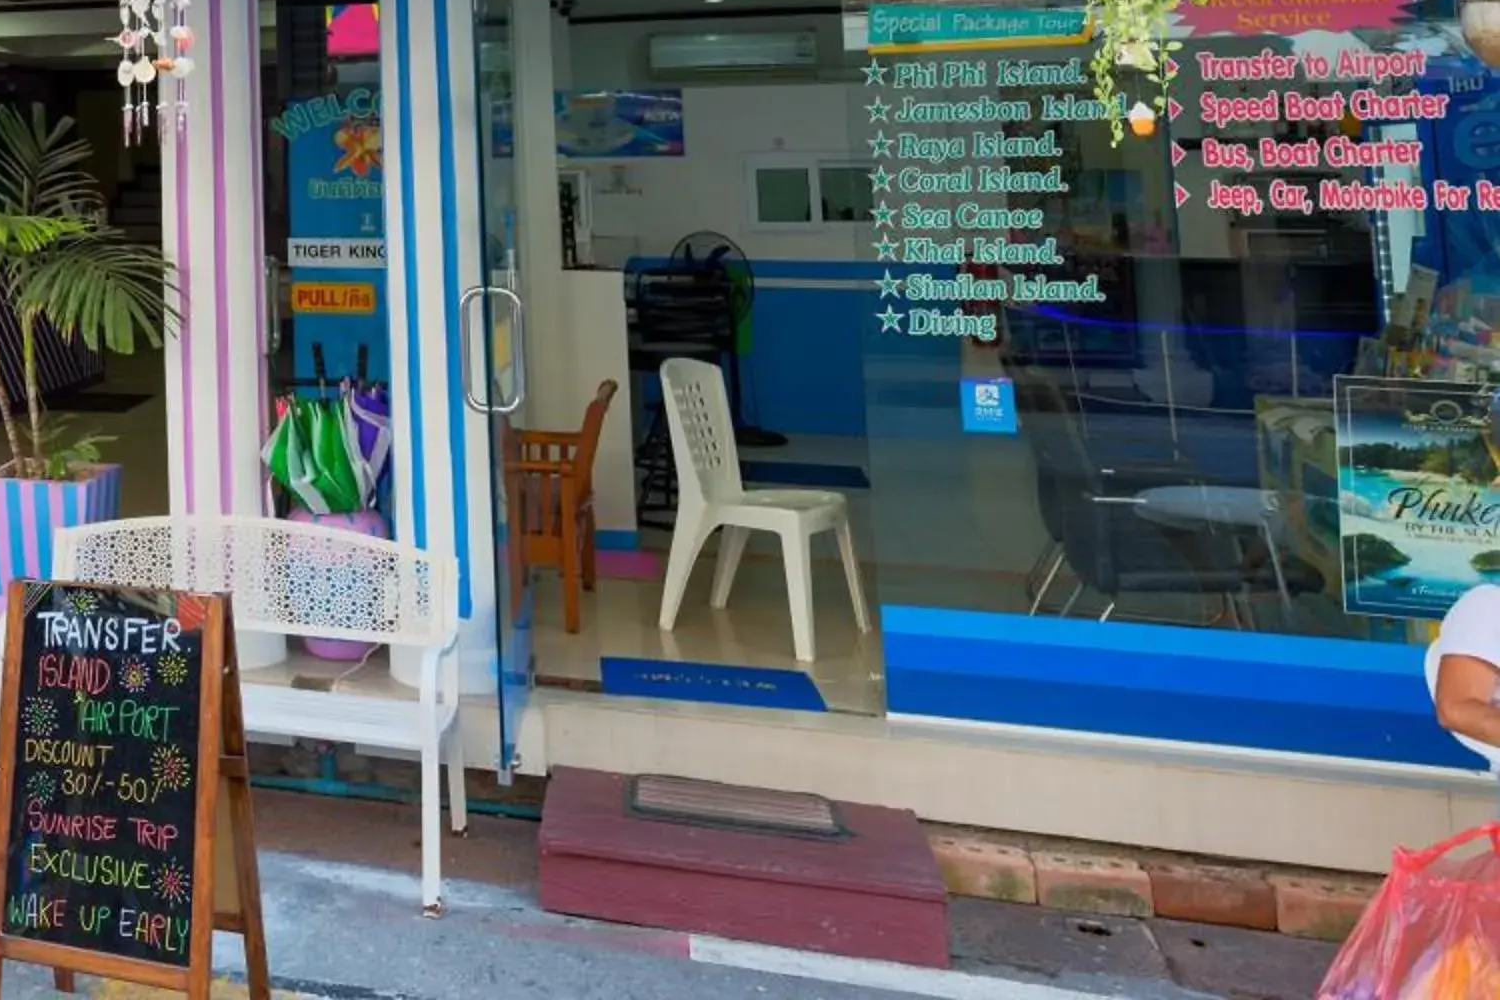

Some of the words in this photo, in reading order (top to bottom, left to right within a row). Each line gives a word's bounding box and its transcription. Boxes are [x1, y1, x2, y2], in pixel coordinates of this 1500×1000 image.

[873, 9, 941, 41] Special
[953, 14, 1029, 34] Package
[1037, 15, 1079, 31] Tour
[1236, 9, 1331, 29] Service
[893, 62, 937, 89] Phi
[942, 60, 987, 88] Phi
[997, 58, 1087, 87] Island.
[1197, 49, 1298, 81] Transfer
[1303, 52, 1331, 80] to
[1337, 49, 1427, 87] Airport
[270, 88, 382, 142] WELC
[895, 97, 1030, 124] Jamesbon
[1201, 90, 1278, 128] Speed
[1284, 91, 1346, 121] Boat
[1350, 89, 1449, 120] Charter
[898, 133, 965, 162] Raya
[972, 131, 1064, 157] Island.
[1202, 137, 1255, 170] Bus,
[1260, 136, 1321, 167] Boat
[1324, 137, 1423, 167] Charter
[899, 167, 972, 193] Coral
[979, 166, 1070, 193] Island.
[1207, 180, 1262, 215] Jeep,
[1270, 179, 1313, 214] Car,
[1320, 179, 1427, 210] Motorbike
[1433, 179, 1471, 211] For
[901, 203, 950, 229] Sea
[956, 202, 1044, 229] Canoe
[292, 244, 341, 259] TIGER
[904, 238, 966, 264] Khai
[973, 238, 1065, 265] Island.
[906, 274, 1007, 301] Similan
[1012, 274, 1106, 302] Island.
[909, 309, 997, 341] Diving
[1387, 484, 1500, 528] Phuke
[38, 653, 111, 695] ISLAND
[25, 738, 114, 769] DISCOUNT
[28, 799, 117, 841] SUNRISE
[127, 817, 179, 852] TRIP
[30, 843, 151, 889] EXCLUSIVE
[10, 892, 68, 929] WAKE
[79, 905, 111, 935] UP
[118, 907, 189, 955] EARLY
